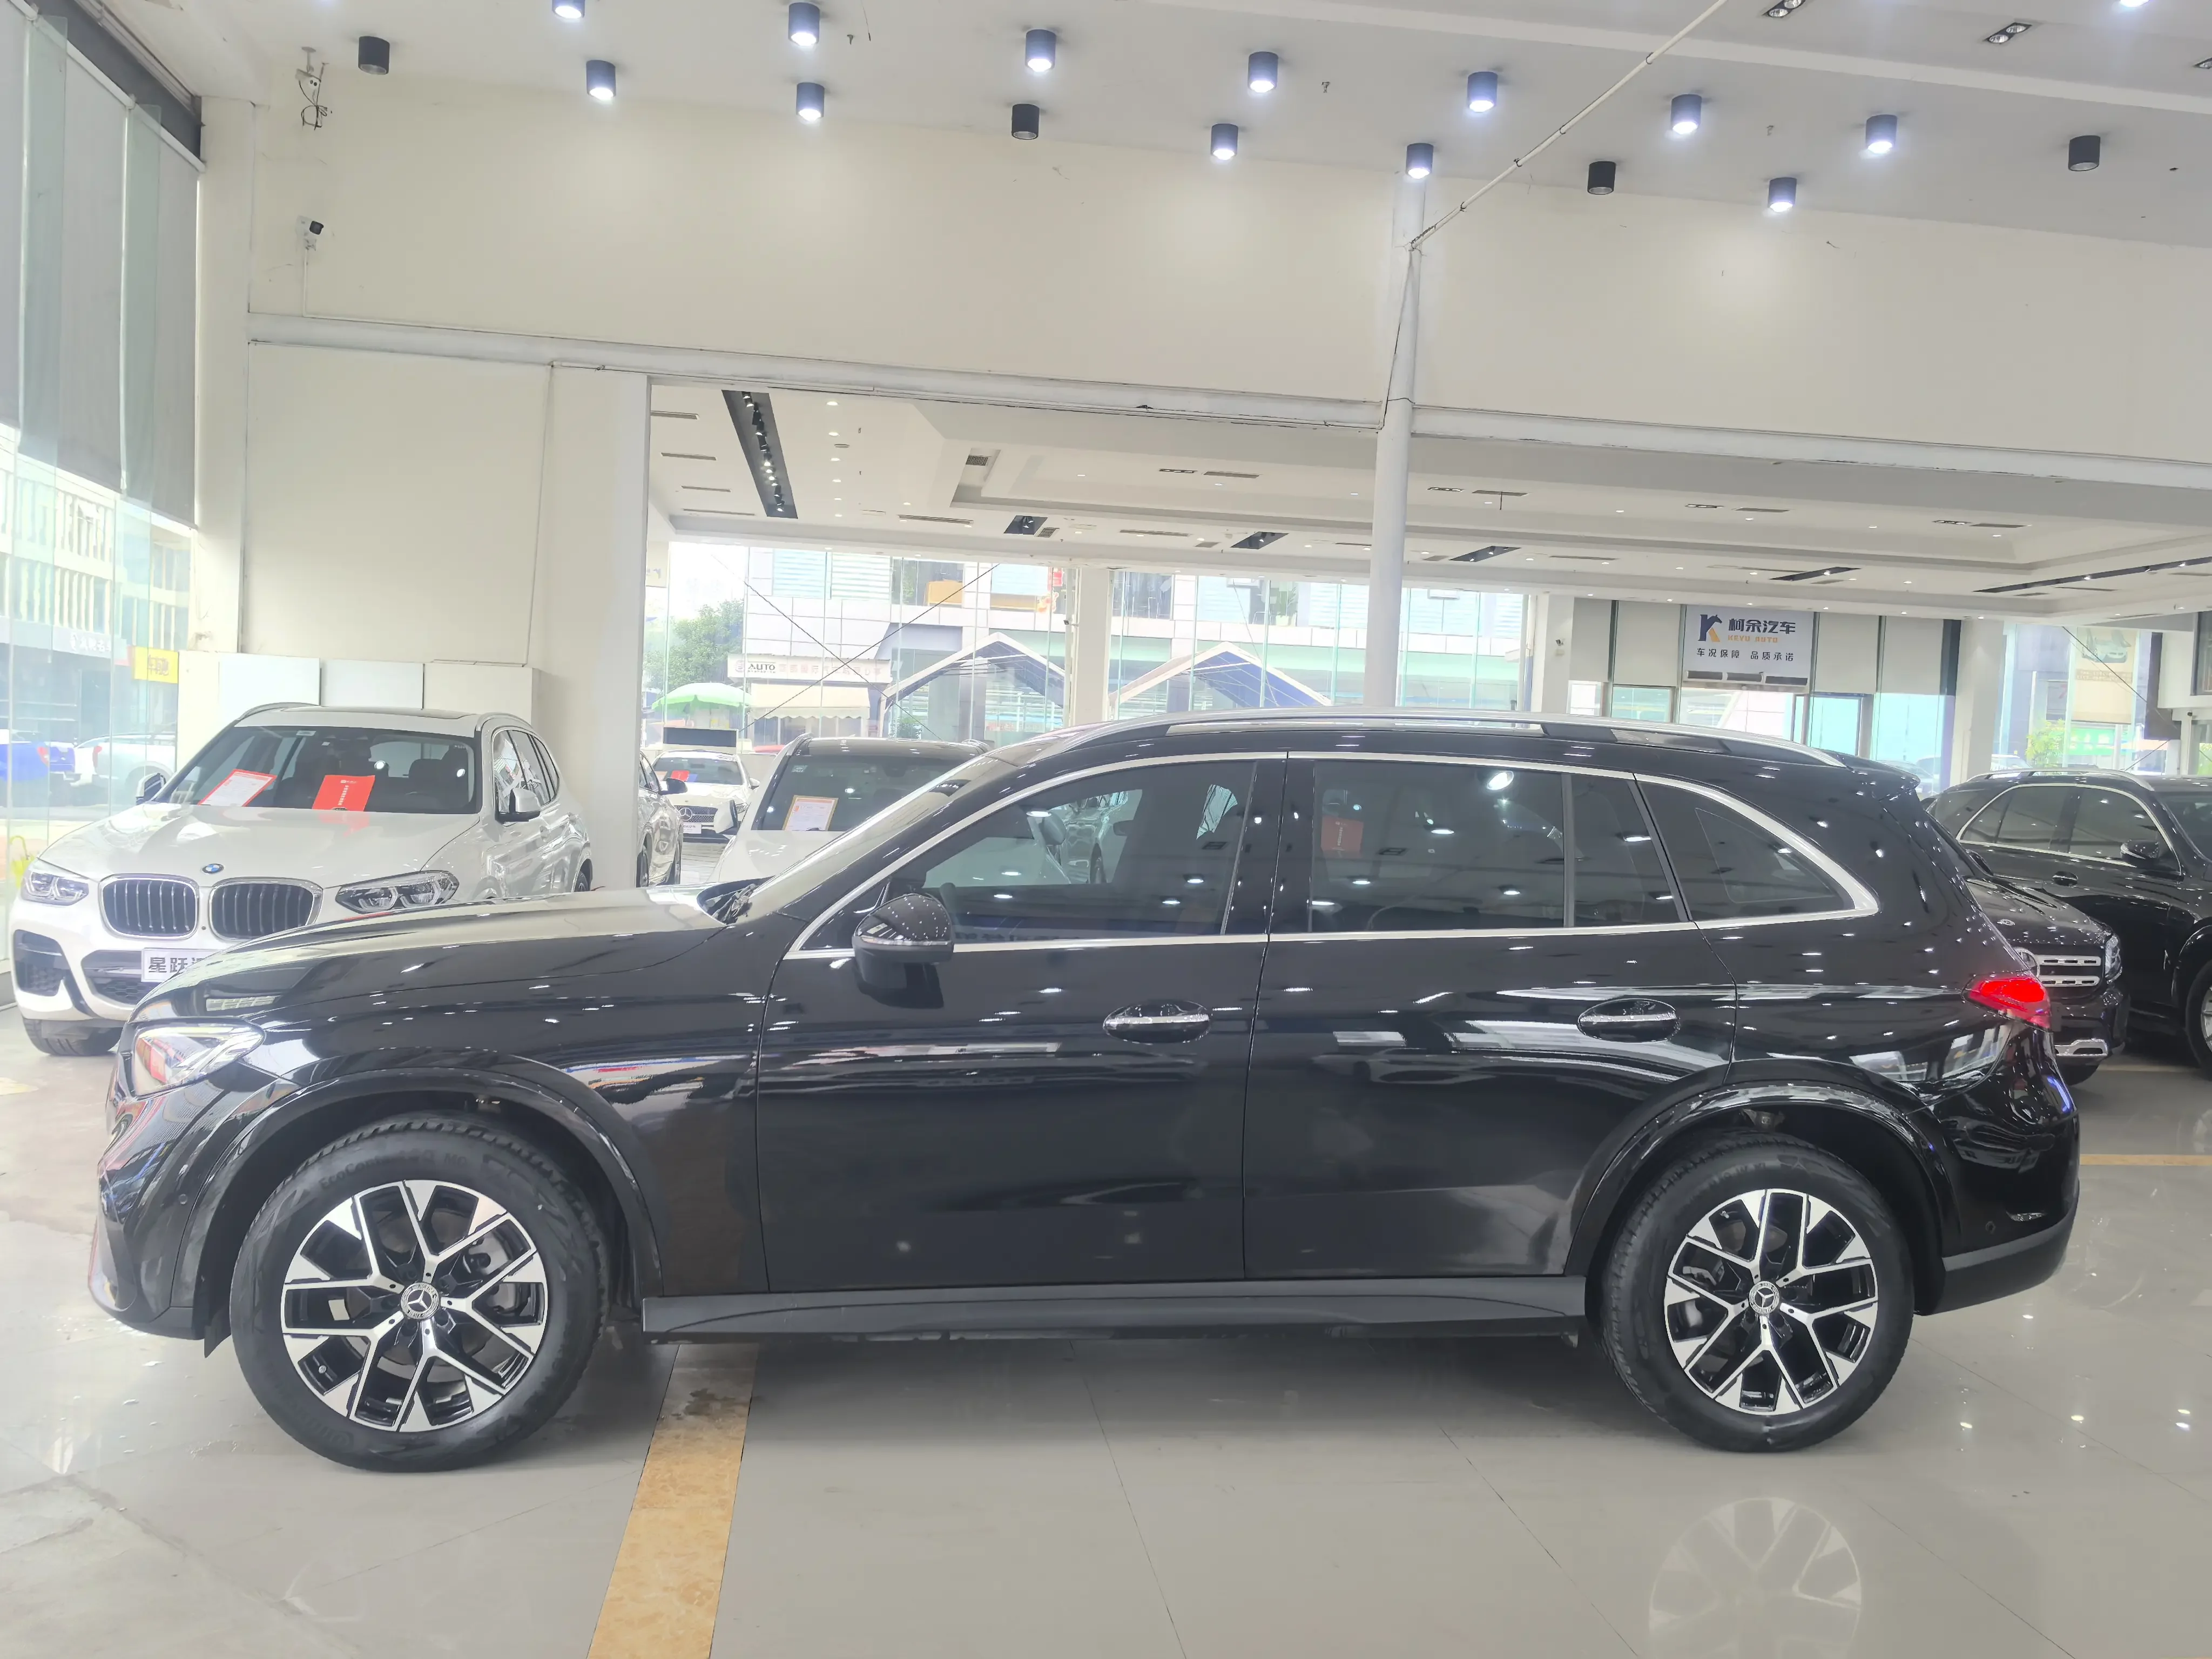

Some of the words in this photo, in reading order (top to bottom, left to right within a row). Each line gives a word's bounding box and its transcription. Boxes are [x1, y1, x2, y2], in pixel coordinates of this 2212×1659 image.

[1728, 618, 1796, 634] 柯余汽车
[1697, 648, 1740, 659] 车况保障
[1750, 651, 1794, 662] 品质承诺
